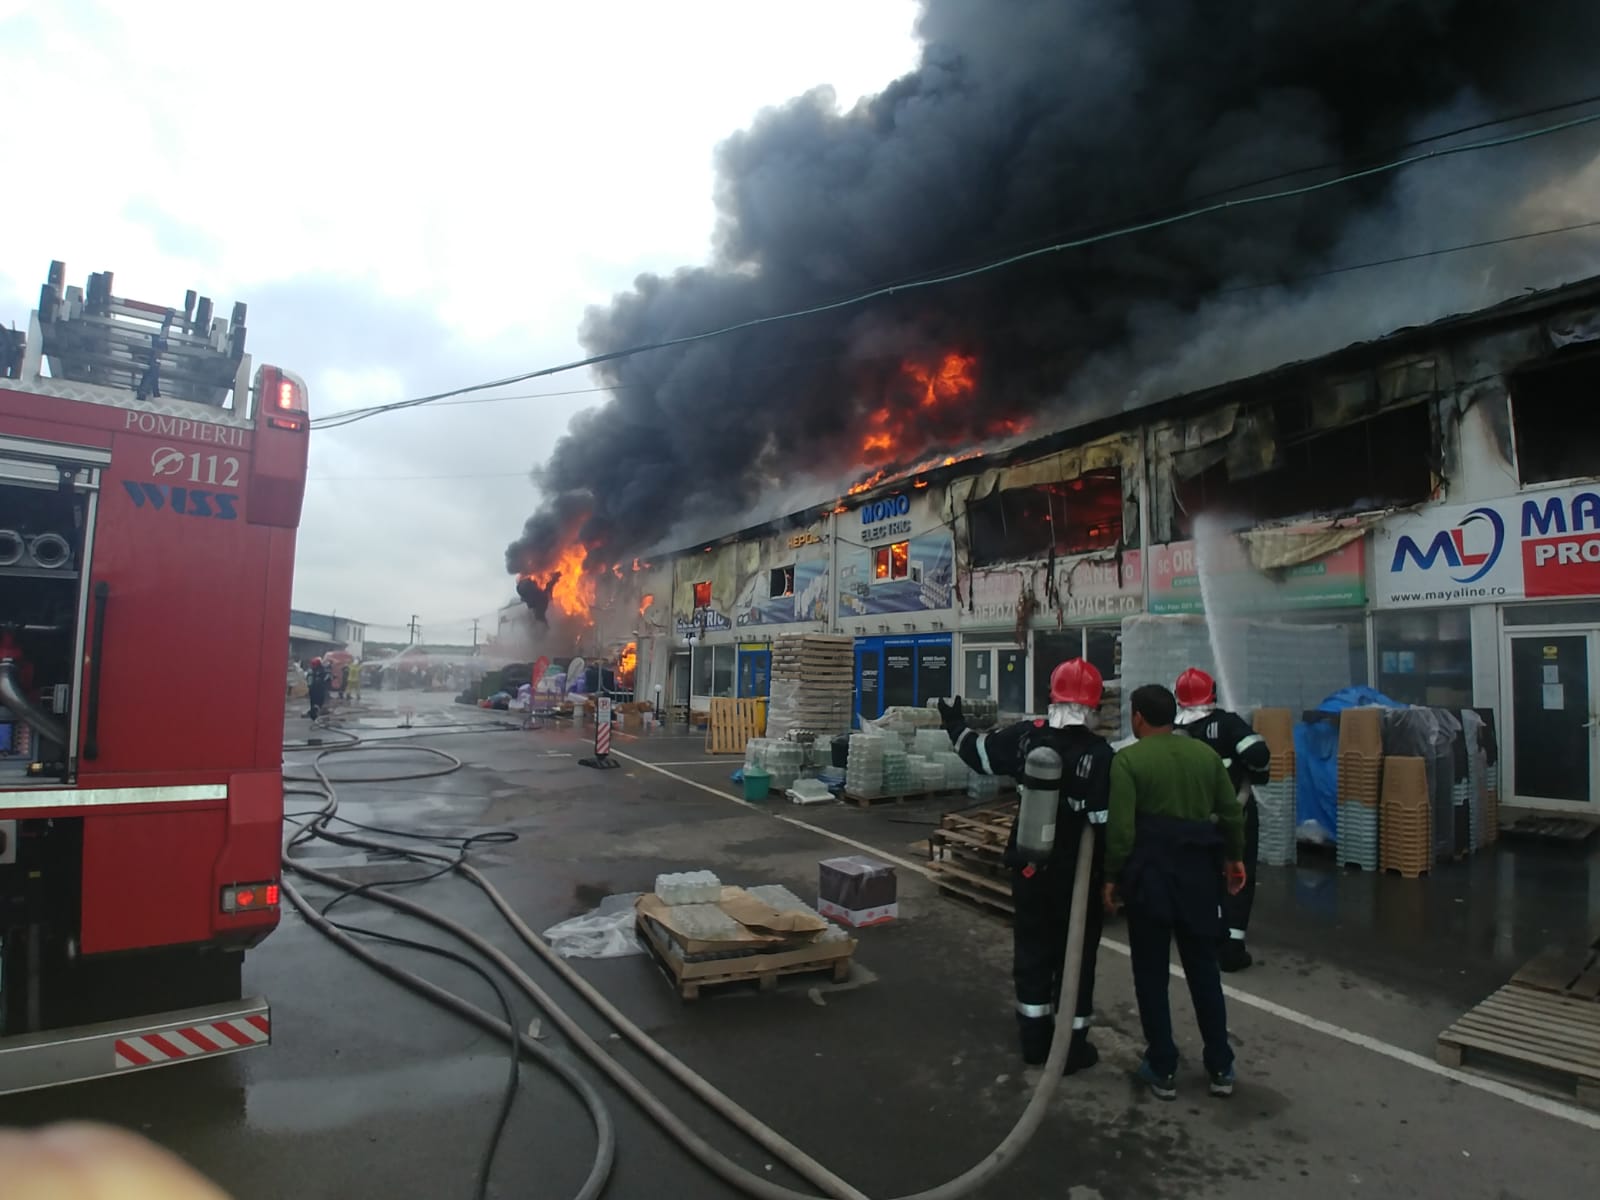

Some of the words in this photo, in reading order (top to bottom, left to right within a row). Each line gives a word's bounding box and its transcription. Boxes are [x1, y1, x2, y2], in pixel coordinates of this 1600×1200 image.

[125, 410, 245, 447] POMPIERII
[189, 452, 240, 487] 112
[121, 480, 240, 521] WISS
[861, 494, 911, 525] MONO
[861, 519, 912, 543] ELECTRIC
[1173, 549, 1194, 573] OR
[974, 602, 1021, 622] DEPOZI
[1063, 595, 1136, 618] APACE.ro
[1391, 586, 1506, 604] www.mayaline.ro
